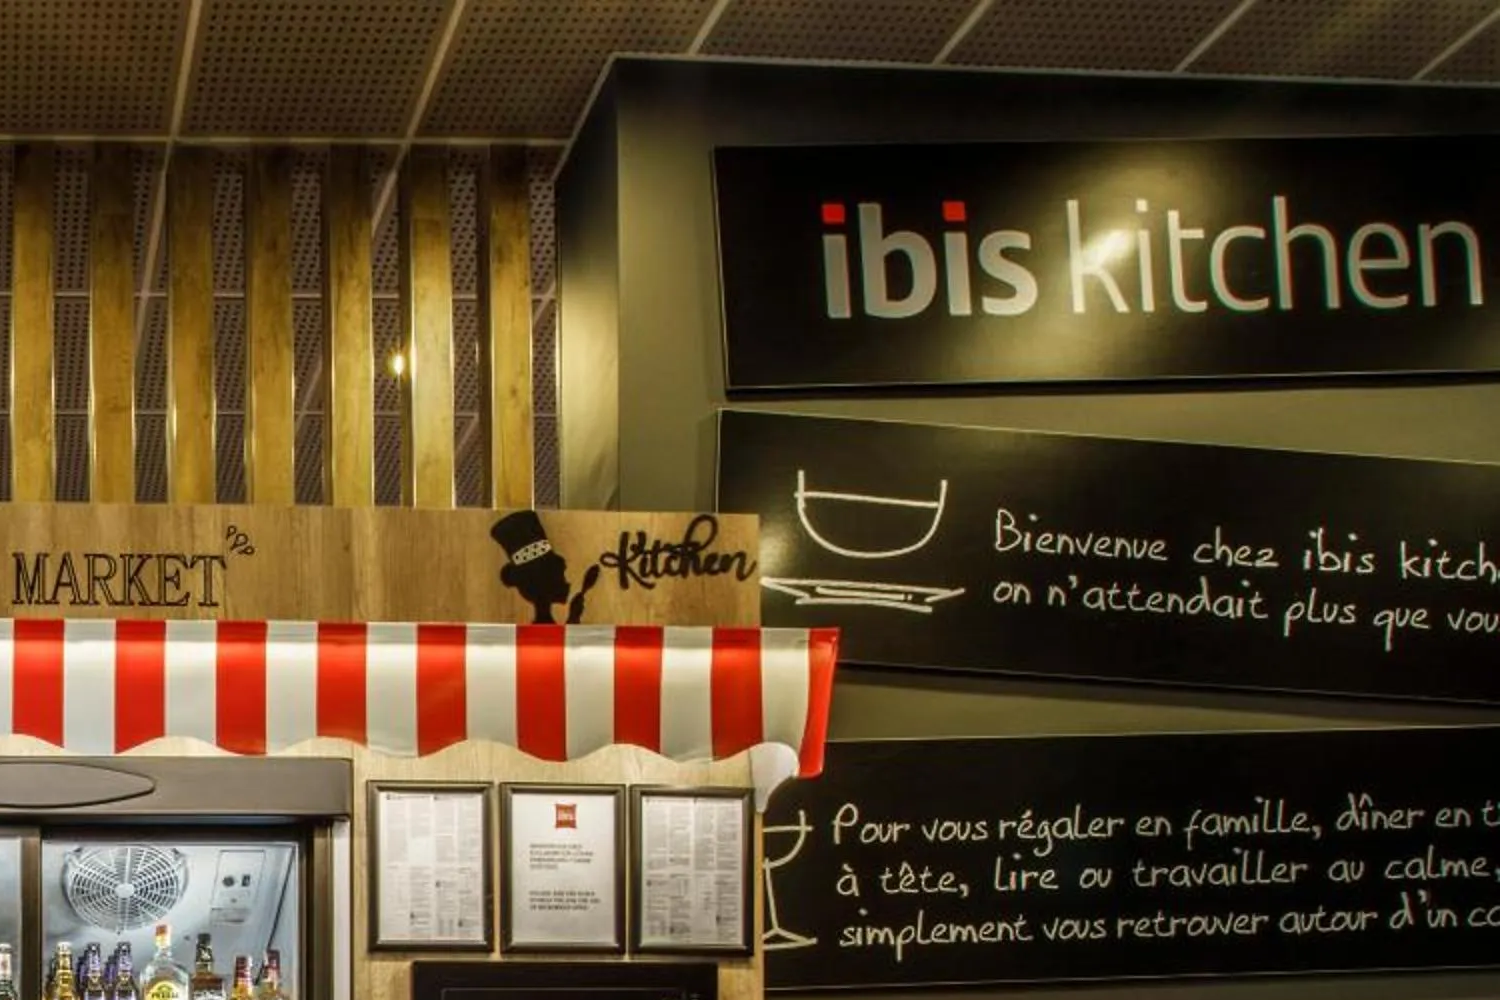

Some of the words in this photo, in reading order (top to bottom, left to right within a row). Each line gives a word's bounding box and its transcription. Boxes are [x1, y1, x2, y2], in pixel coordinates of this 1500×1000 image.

[821, 201, 1039, 319] ibis
[1067, 196, 1484, 315] kitchen
[11, 552, 227, 607] MARKET
[600, 514, 756, 590] Kitchen
[994, 508, 1167, 560] Bienvenue
[1193, 526, 1279, 568] chez
[1304, 528, 1374, 573] ibis
[1400, 539, 1500, 583] kitch
[993, 581, 1030, 604] on
[1048, 575, 1268, 619] n'attendait
[1284, 588, 1356, 636] plus
[1373, 608, 1430, 651] que
[1447, 608, 1499, 632] vou
[832, 803, 910, 844] Pour
[922, 814, 988, 843] vous
[999, 804, 1124, 860] régaler
[1136, 816, 1172, 836] en
[1184, 796, 1321, 850] famille,
[1336, 793, 1424, 831] dîner
[1436, 803, 1471, 828] en
[1481, 800, 1500, 827] t
[836, 864, 859, 896] à
[880, 862, 968, 897] tête,
[1079, 868, 1112, 888] ou
[1132, 848, 1308, 887] travailler
[1328, 860, 1364, 882] au
[839, 908, 1033, 962] simplement
[1043, 918, 1106, 940] vous
[1117, 911, 1269, 938] retrouver
[1279, 906, 1378, 934] autour
[1389, 889, 1457, 929] d'un
